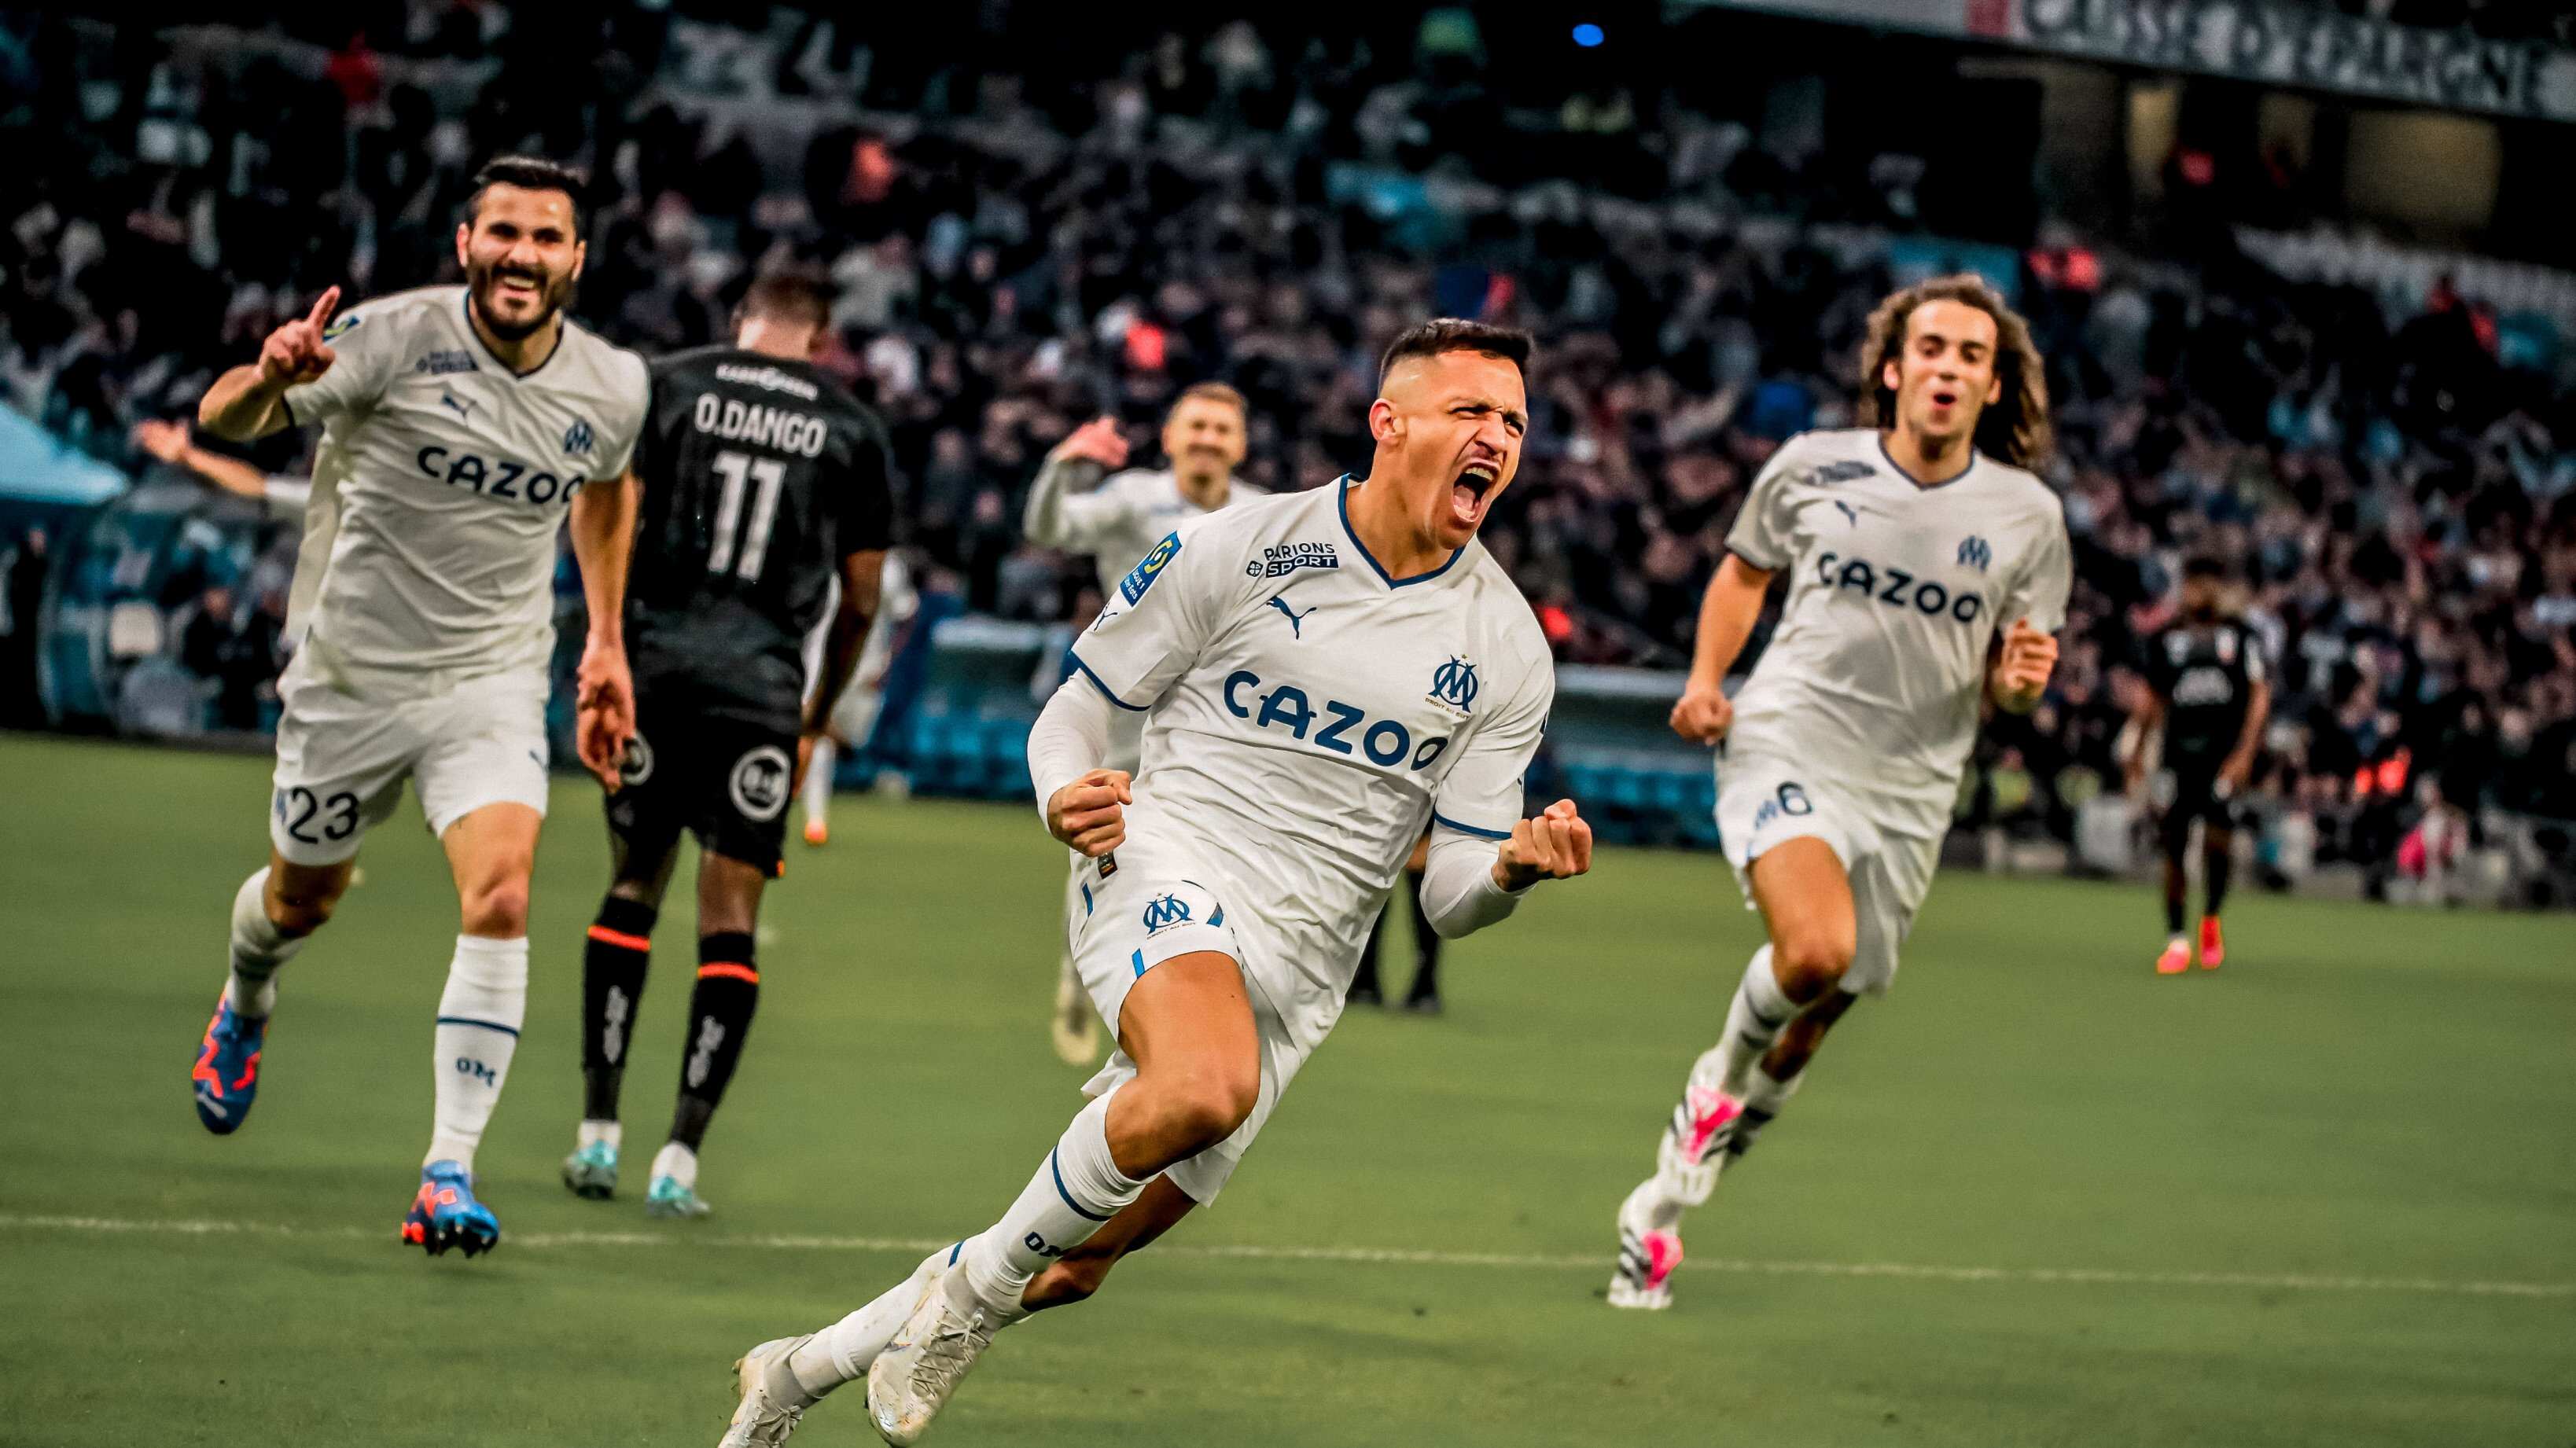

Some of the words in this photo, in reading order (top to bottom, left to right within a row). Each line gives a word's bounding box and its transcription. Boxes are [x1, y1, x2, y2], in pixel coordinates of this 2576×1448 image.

[694, 393, 826, 458] O.DANGO
[708, 450, 786, 580] 11
[1264, 542, 1335, 560] PARIONS
[1268, 557, 1335, 575] SPORT
[1818, 552, 1981, 623] CAZOO
[1224, 671, 1448, 771] CAZOO
[289, 786, 359, 844] 23
[1776, 781, 1813, 815] 6
[455, 1057, 497, 1087] OM
